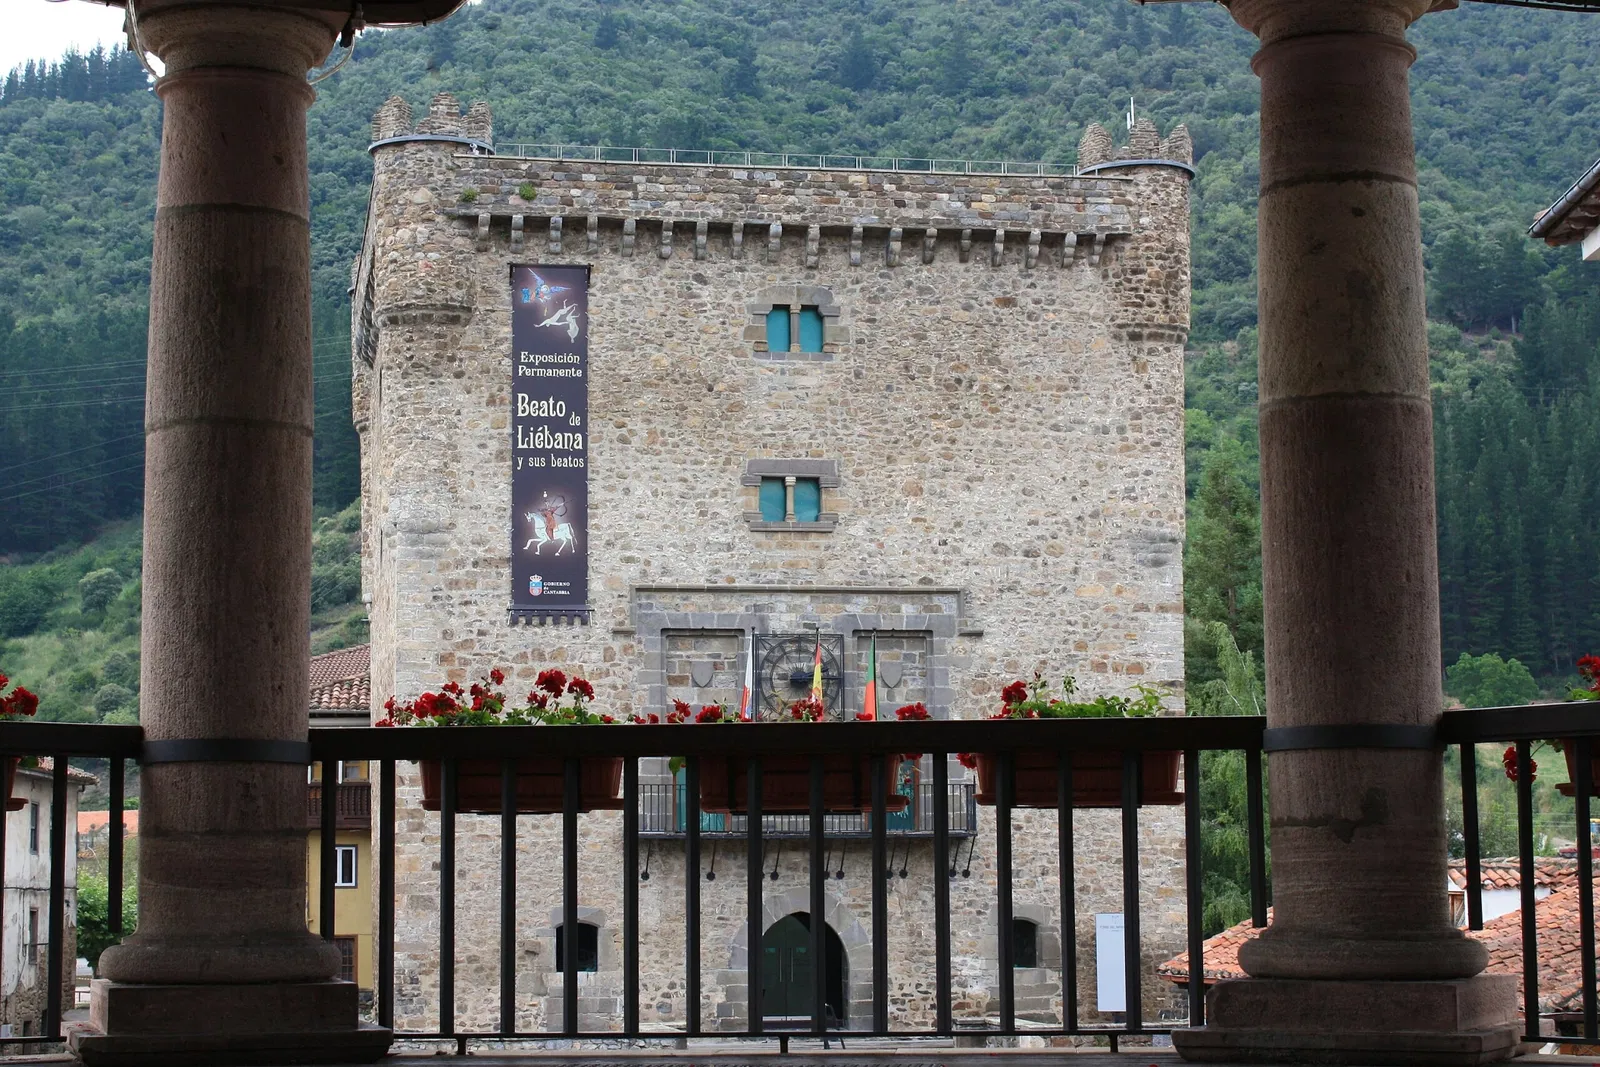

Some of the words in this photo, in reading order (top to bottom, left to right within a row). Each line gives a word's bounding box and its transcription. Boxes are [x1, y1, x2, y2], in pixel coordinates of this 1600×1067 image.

[520, 351, 580, 366] Exposición
[518, 366, 582, 378] Permanente
[516, 393, 566, 417] Beato
[569, 412, 581, 426] de
[516, 425, 583, 451] Liébana
[517, 456, 524, 470] y
[528, 458, 546, 467] sus
[551, 454, 584, 468] beatos
